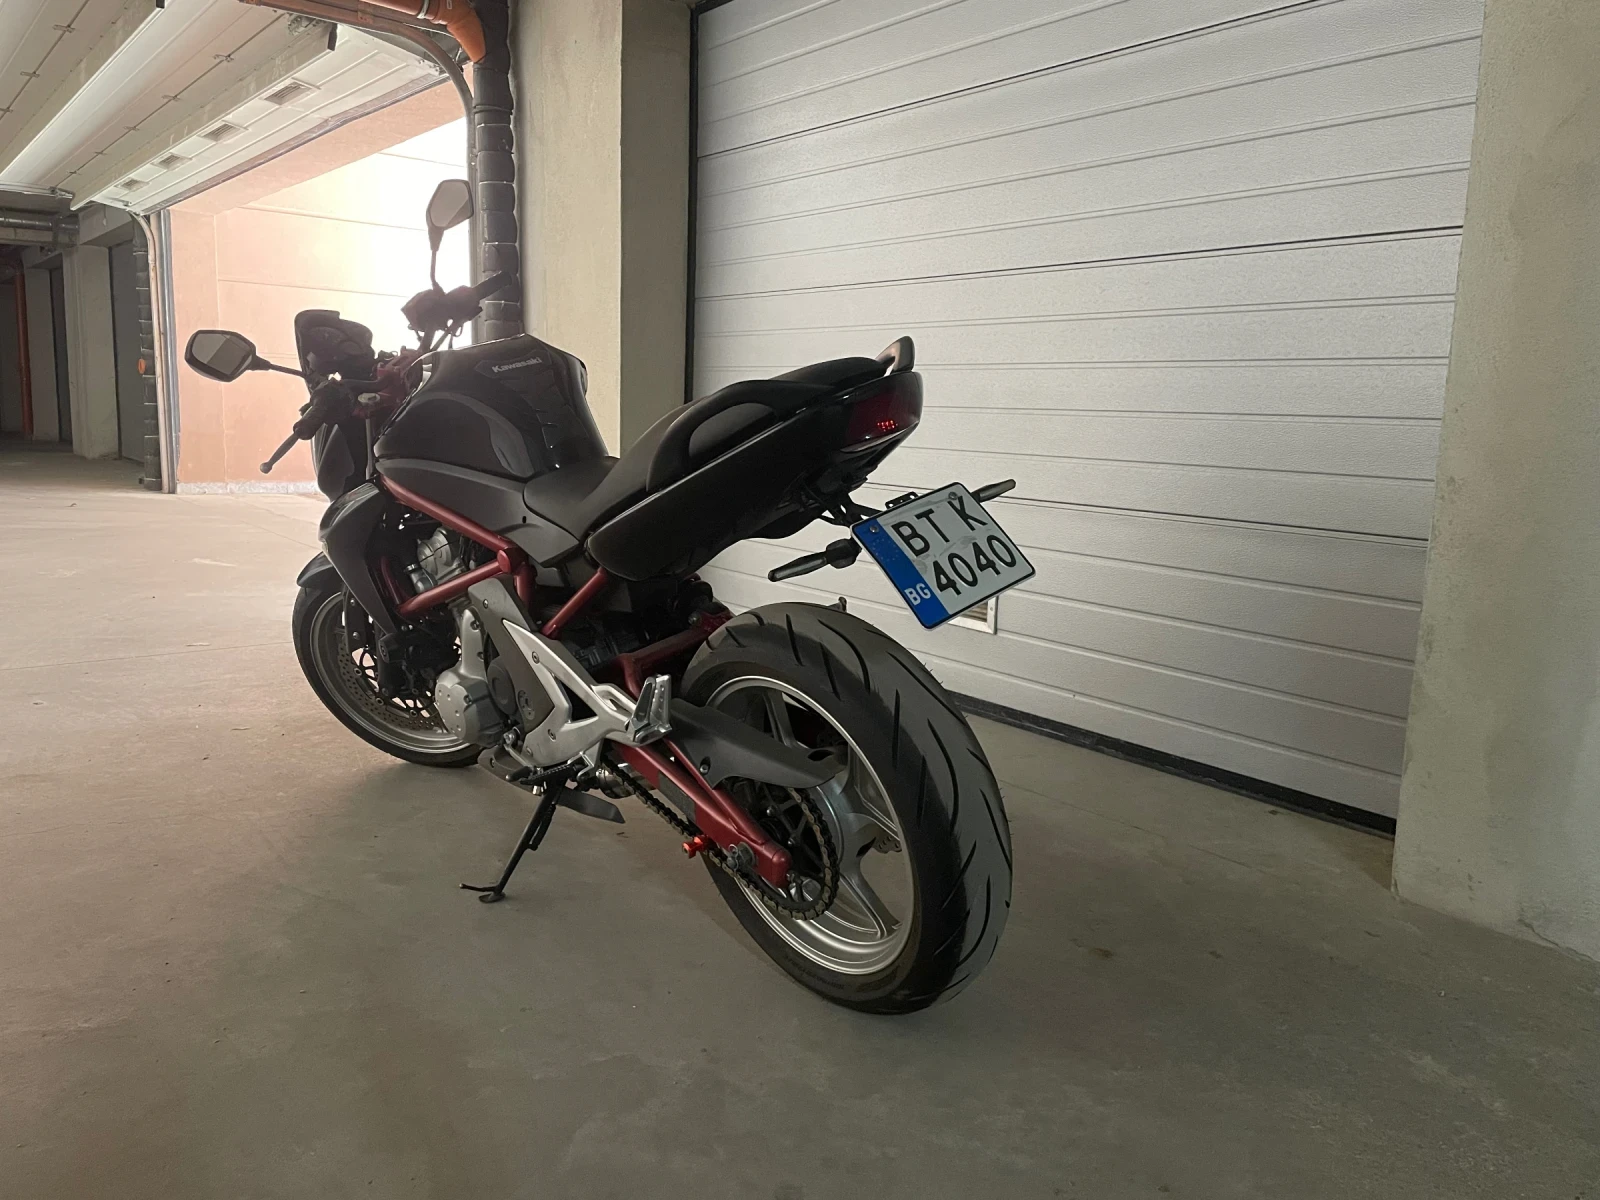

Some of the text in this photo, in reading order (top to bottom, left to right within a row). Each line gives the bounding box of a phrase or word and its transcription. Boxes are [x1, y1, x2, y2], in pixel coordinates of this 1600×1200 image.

[491, 356, 543, 373] Kawasaki
[933, 535, 1017, 596] 4040
[904, 582, 931, 606] BG
